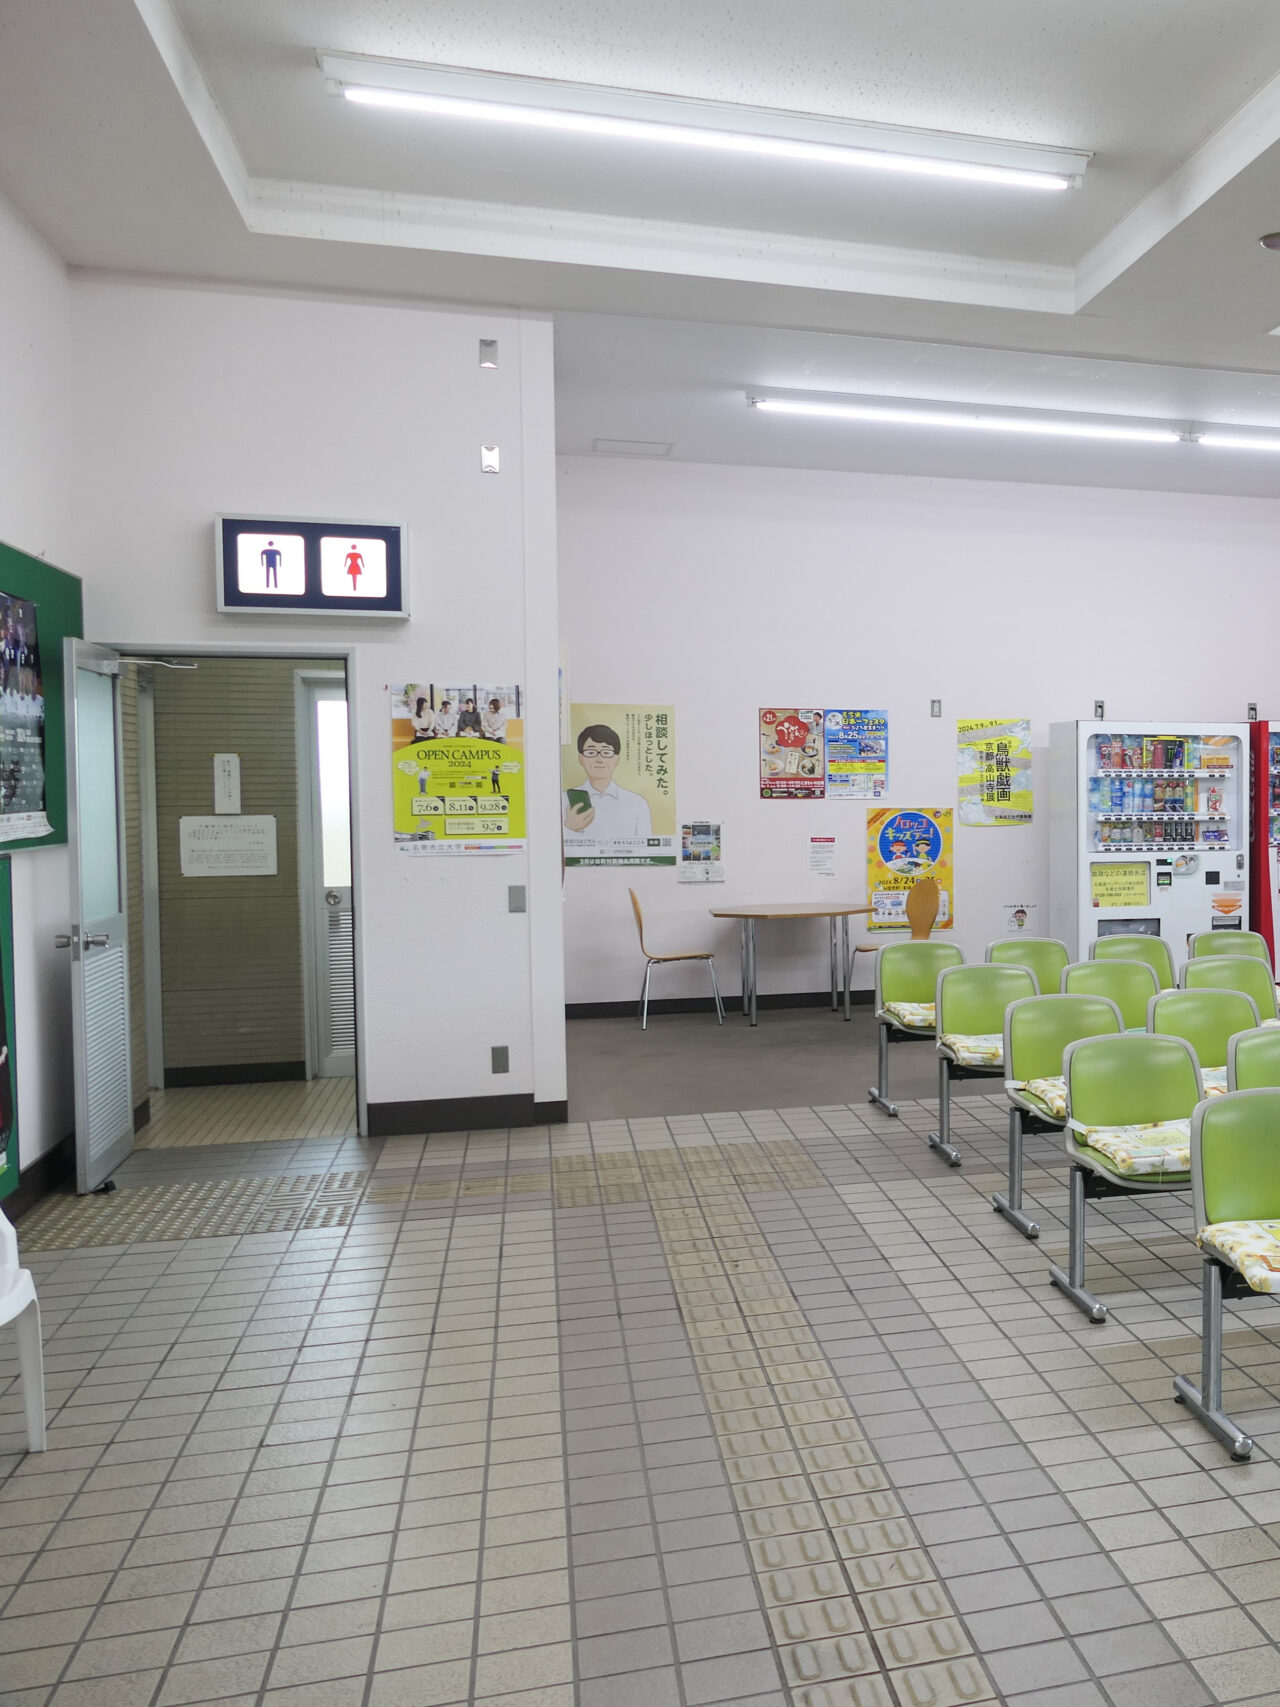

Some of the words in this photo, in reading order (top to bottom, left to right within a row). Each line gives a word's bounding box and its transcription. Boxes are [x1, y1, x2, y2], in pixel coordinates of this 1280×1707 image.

[842, 718, 885, 726] 日本一フェスタ
[644, 713, 654, 777] 少しほっとした。
[985, 742, 995, 761] 京都
[416, 749, 450, 760] OPEN
[451, 749, 502, 760] CAMPUS
[655, 713, 669, 796] 相談してみた。
[448, 760, 472, 768] 2024
[995, 741, 1011, 802] 鳥獣戯画
[985, 764, 996, 802] 高山寺展
[893, 815, 929, 829] ノロッコ
[893, 876, 915, 885] 8/24
